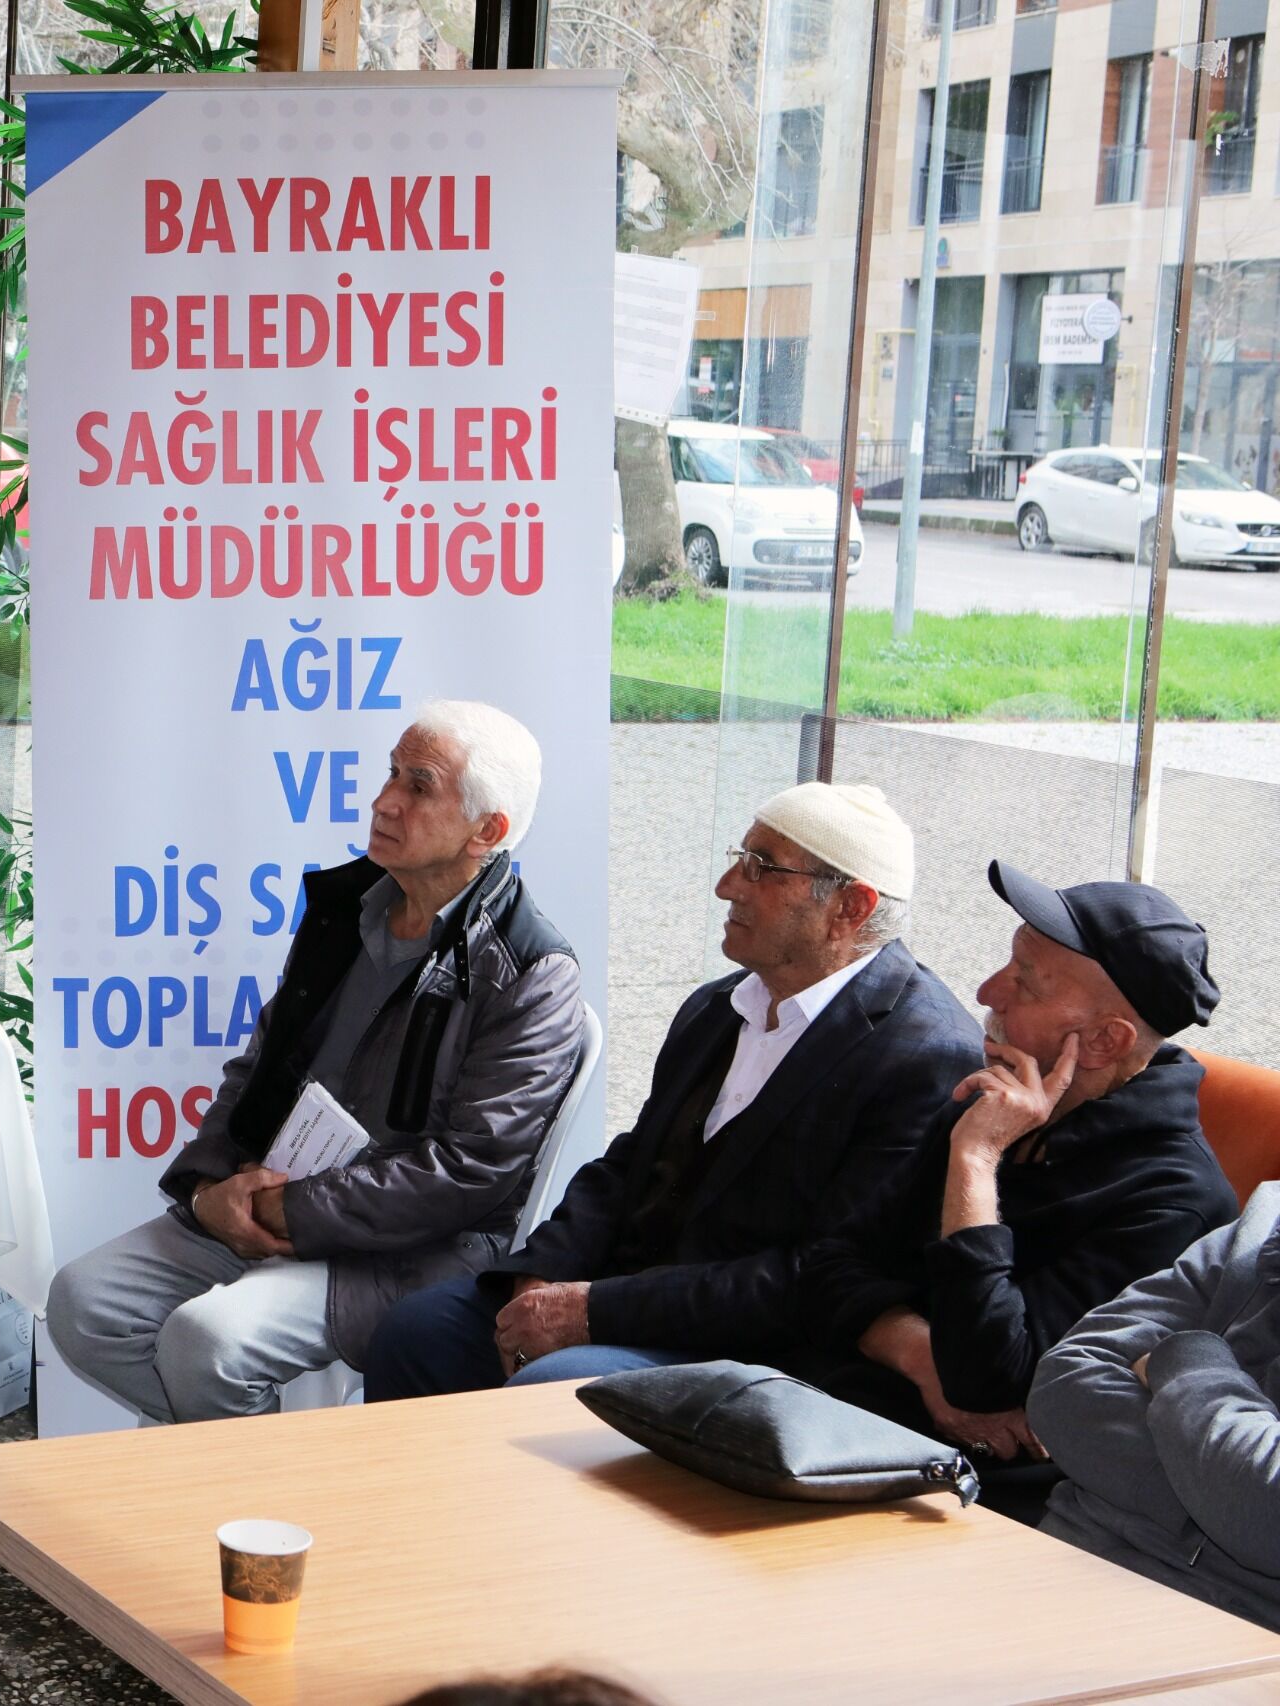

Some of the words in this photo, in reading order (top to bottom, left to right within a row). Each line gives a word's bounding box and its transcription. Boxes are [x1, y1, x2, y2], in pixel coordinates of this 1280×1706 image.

[144, 175, 491, 254] BAYRAKLI
[130, 271, 505, 370] BELEDİYESİ
[76, 390, 325, 487] SAĞLIK
[353, 387, 558, 503] İŞLERİ
[89, 502, 544, 600] MÜDÜRLÜĞÜ
[231, 618, 403, 712] AĞIZ
[273, 751, 359, 823] VE
[114, 845, 222, 956] DİŞ
[53, 975, 282, 1048] TOPLA
